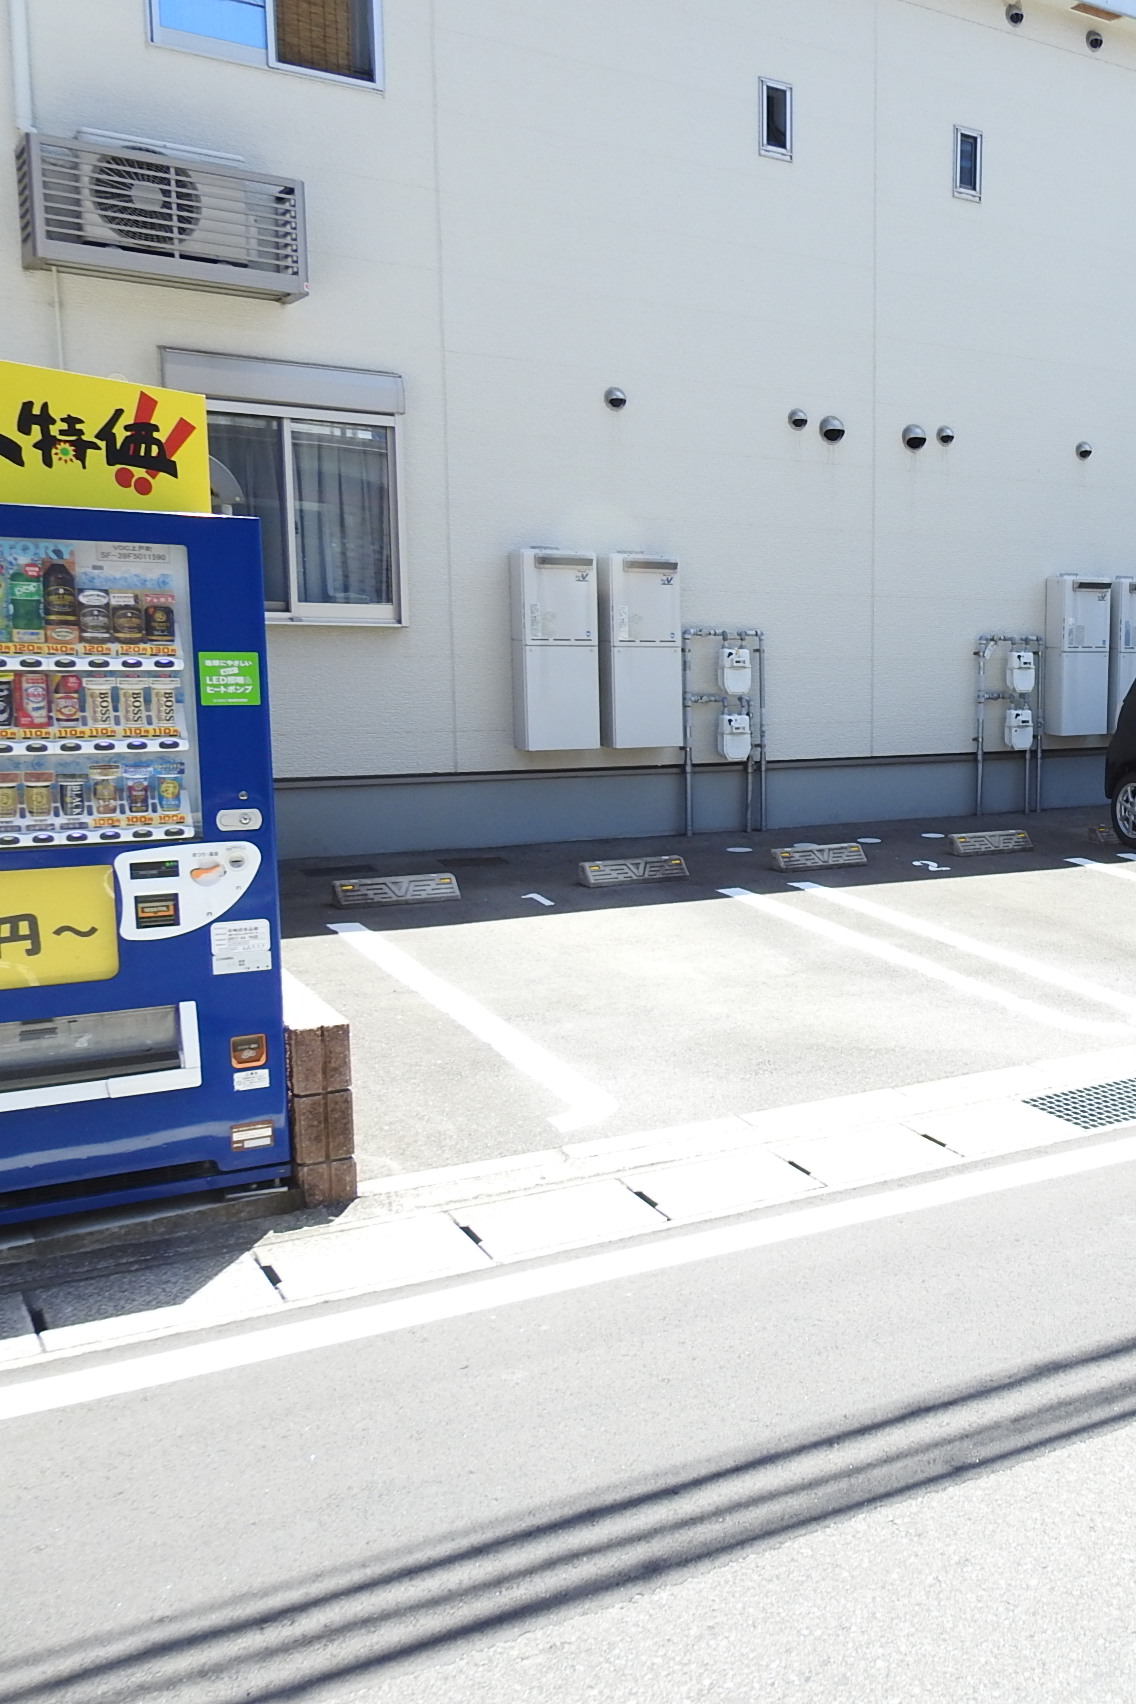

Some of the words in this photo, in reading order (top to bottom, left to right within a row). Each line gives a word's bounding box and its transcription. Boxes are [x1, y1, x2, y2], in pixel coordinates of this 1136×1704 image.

[0, 391, 196, 495] 特価!!
[83, 645, 111, 653] 120円
[120, 645, 148, 653] 120円
[149, 646, 177, 654] 130円
[99, 692, 111, 722] BOSS
[132, 692, 142, 722] BOSS
[164, 692, 175, 722] BOSS
[22, 729, 51, 737] 110円
[152, 727, 179, 735] 110円
[72, 785, 83, 815] BLACK
[126, 816, 153, 824] 100円
